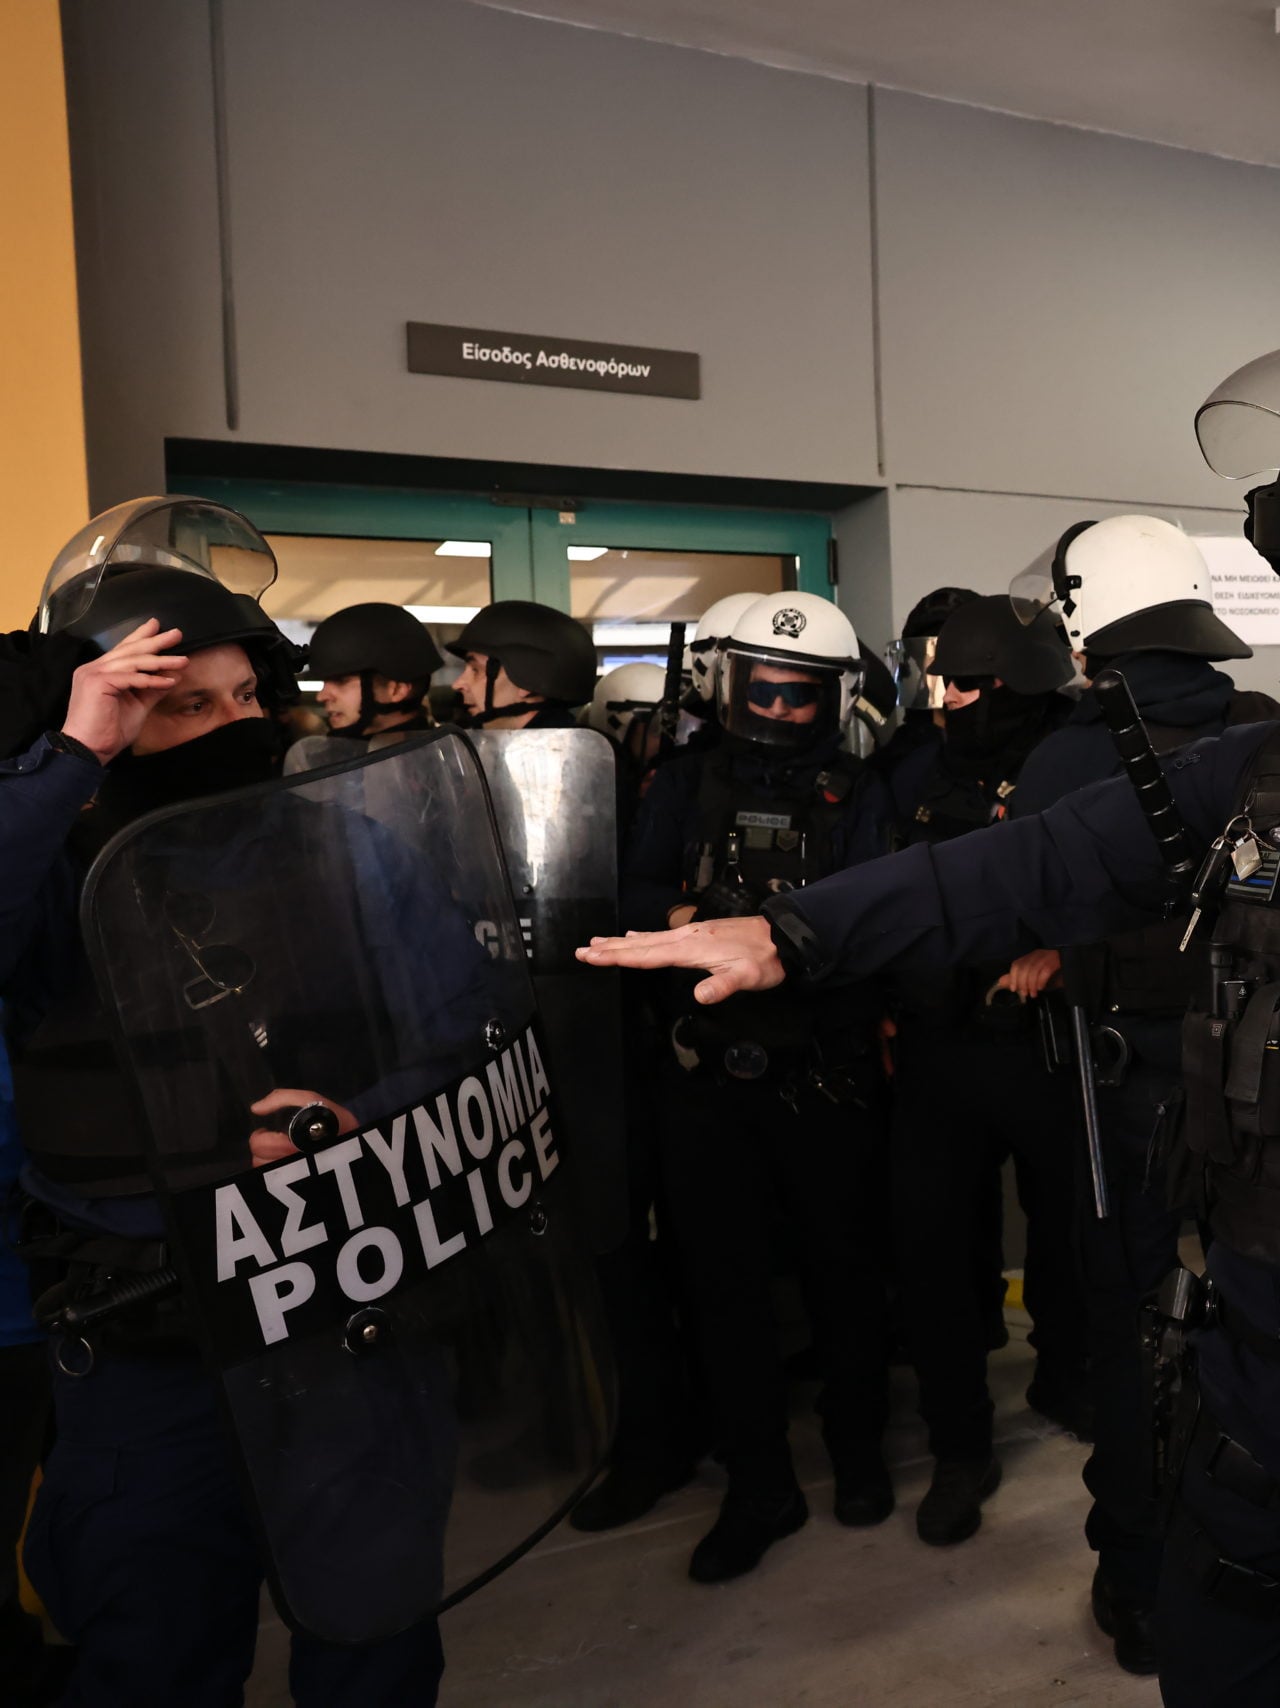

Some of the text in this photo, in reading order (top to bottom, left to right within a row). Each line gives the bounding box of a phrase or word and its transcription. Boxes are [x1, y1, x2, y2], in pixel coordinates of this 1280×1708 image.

[462, 342, 651, 378] Είσοδος Ασθενοφόρων
[739, 814, 788, 826] POLICE
[214, 1025, 551, 1283] ΑΣΤΥΝΟΜΙΑ
[247, 1108, 560, 1346] POLICE
